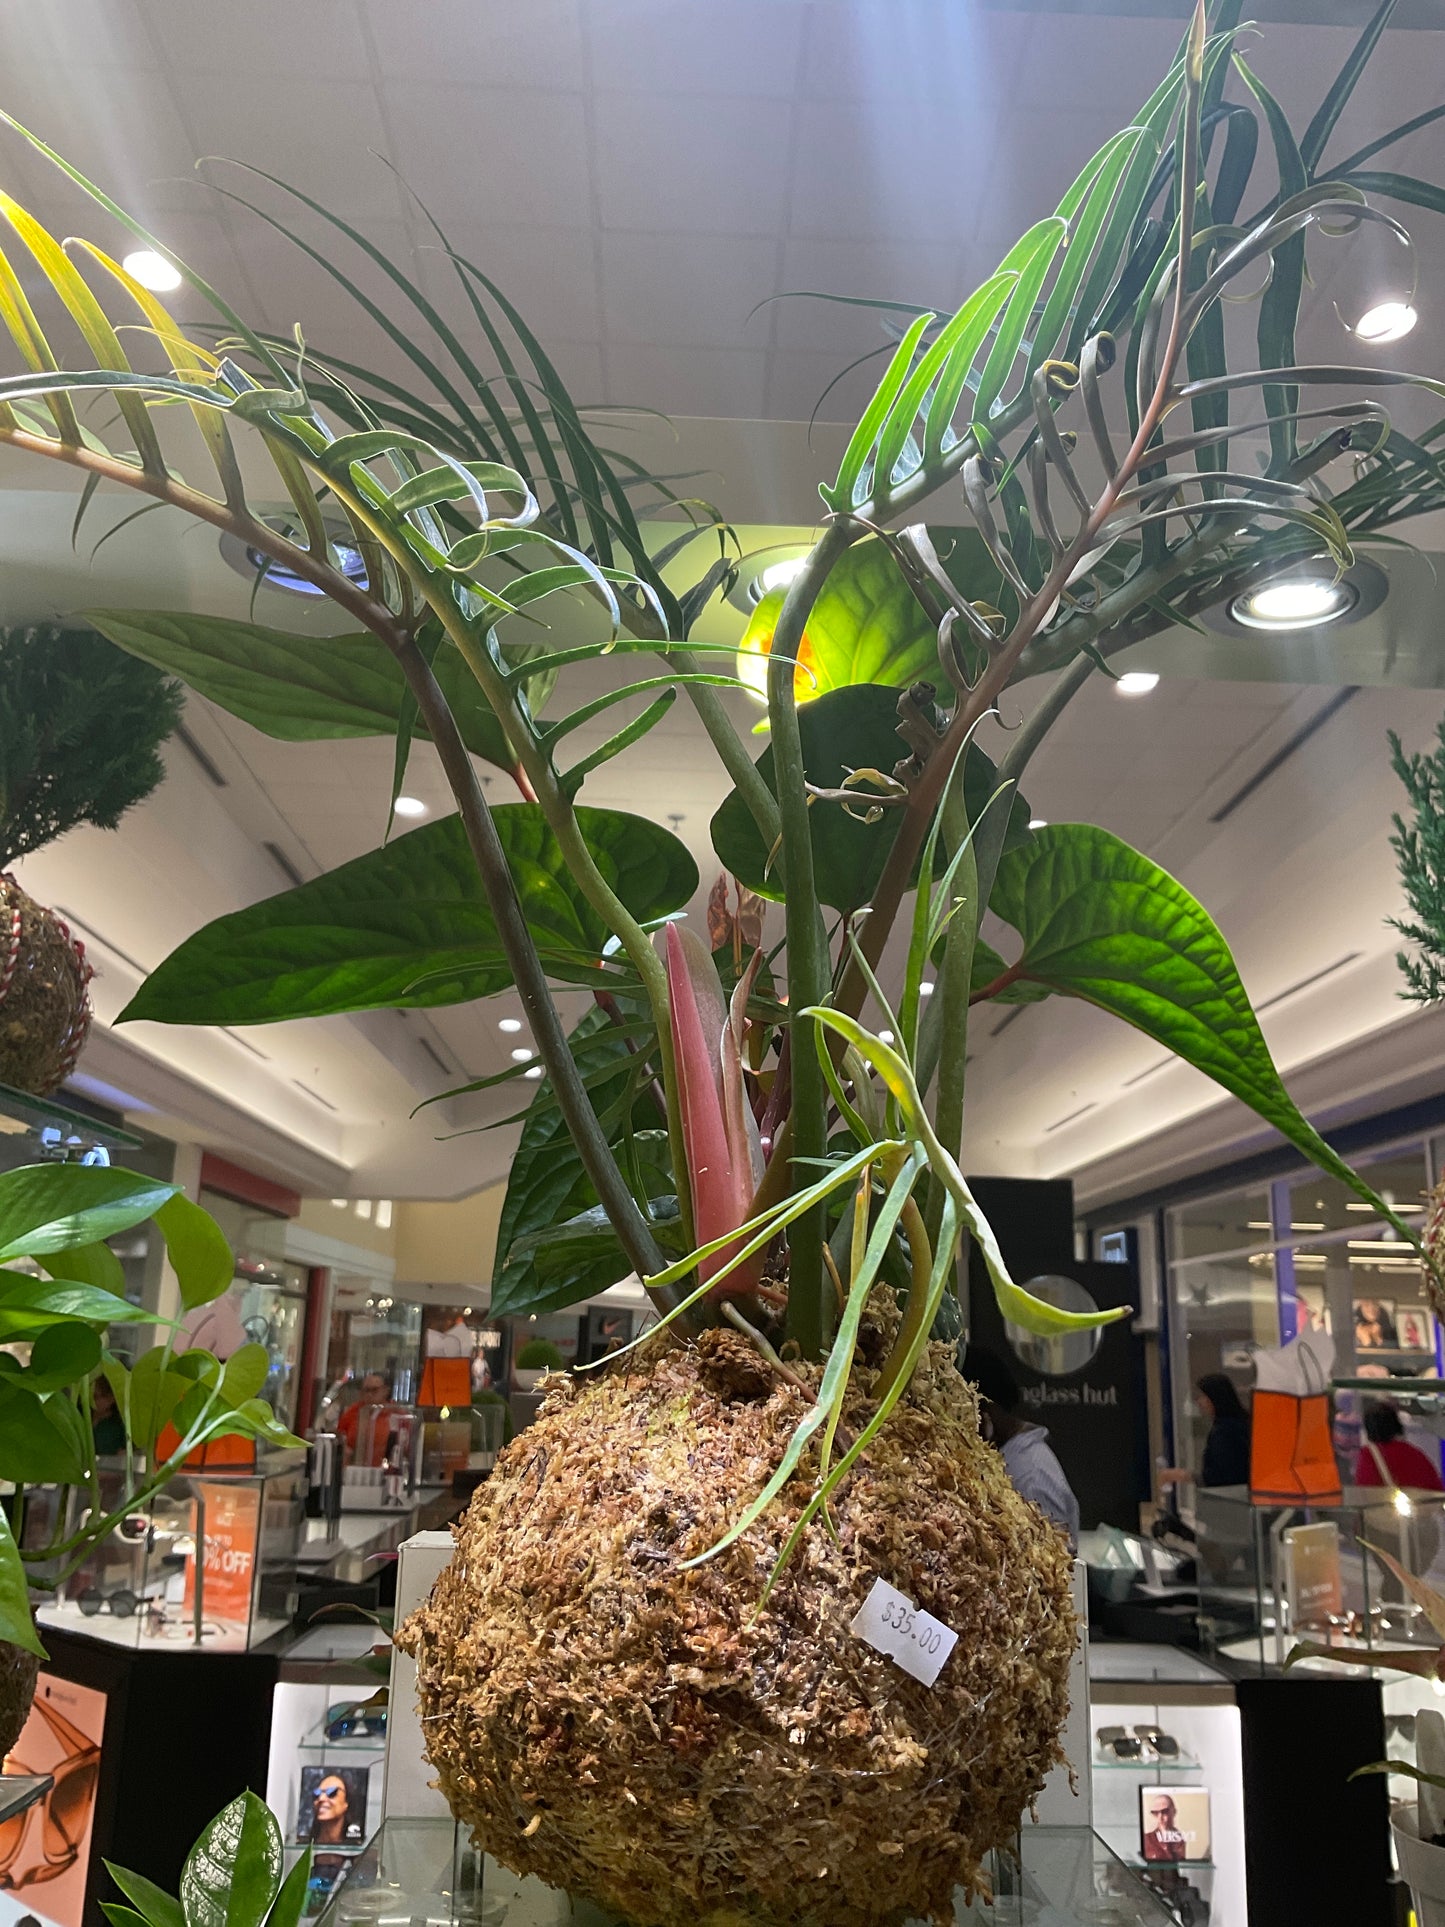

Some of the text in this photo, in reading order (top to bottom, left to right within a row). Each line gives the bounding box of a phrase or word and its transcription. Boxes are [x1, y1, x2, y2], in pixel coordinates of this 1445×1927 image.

[1082, 1381, 1118, 1405] hut
[221, 1549, 252, 1575] OFF
[881, 1601, 942, 1655] $35.00
